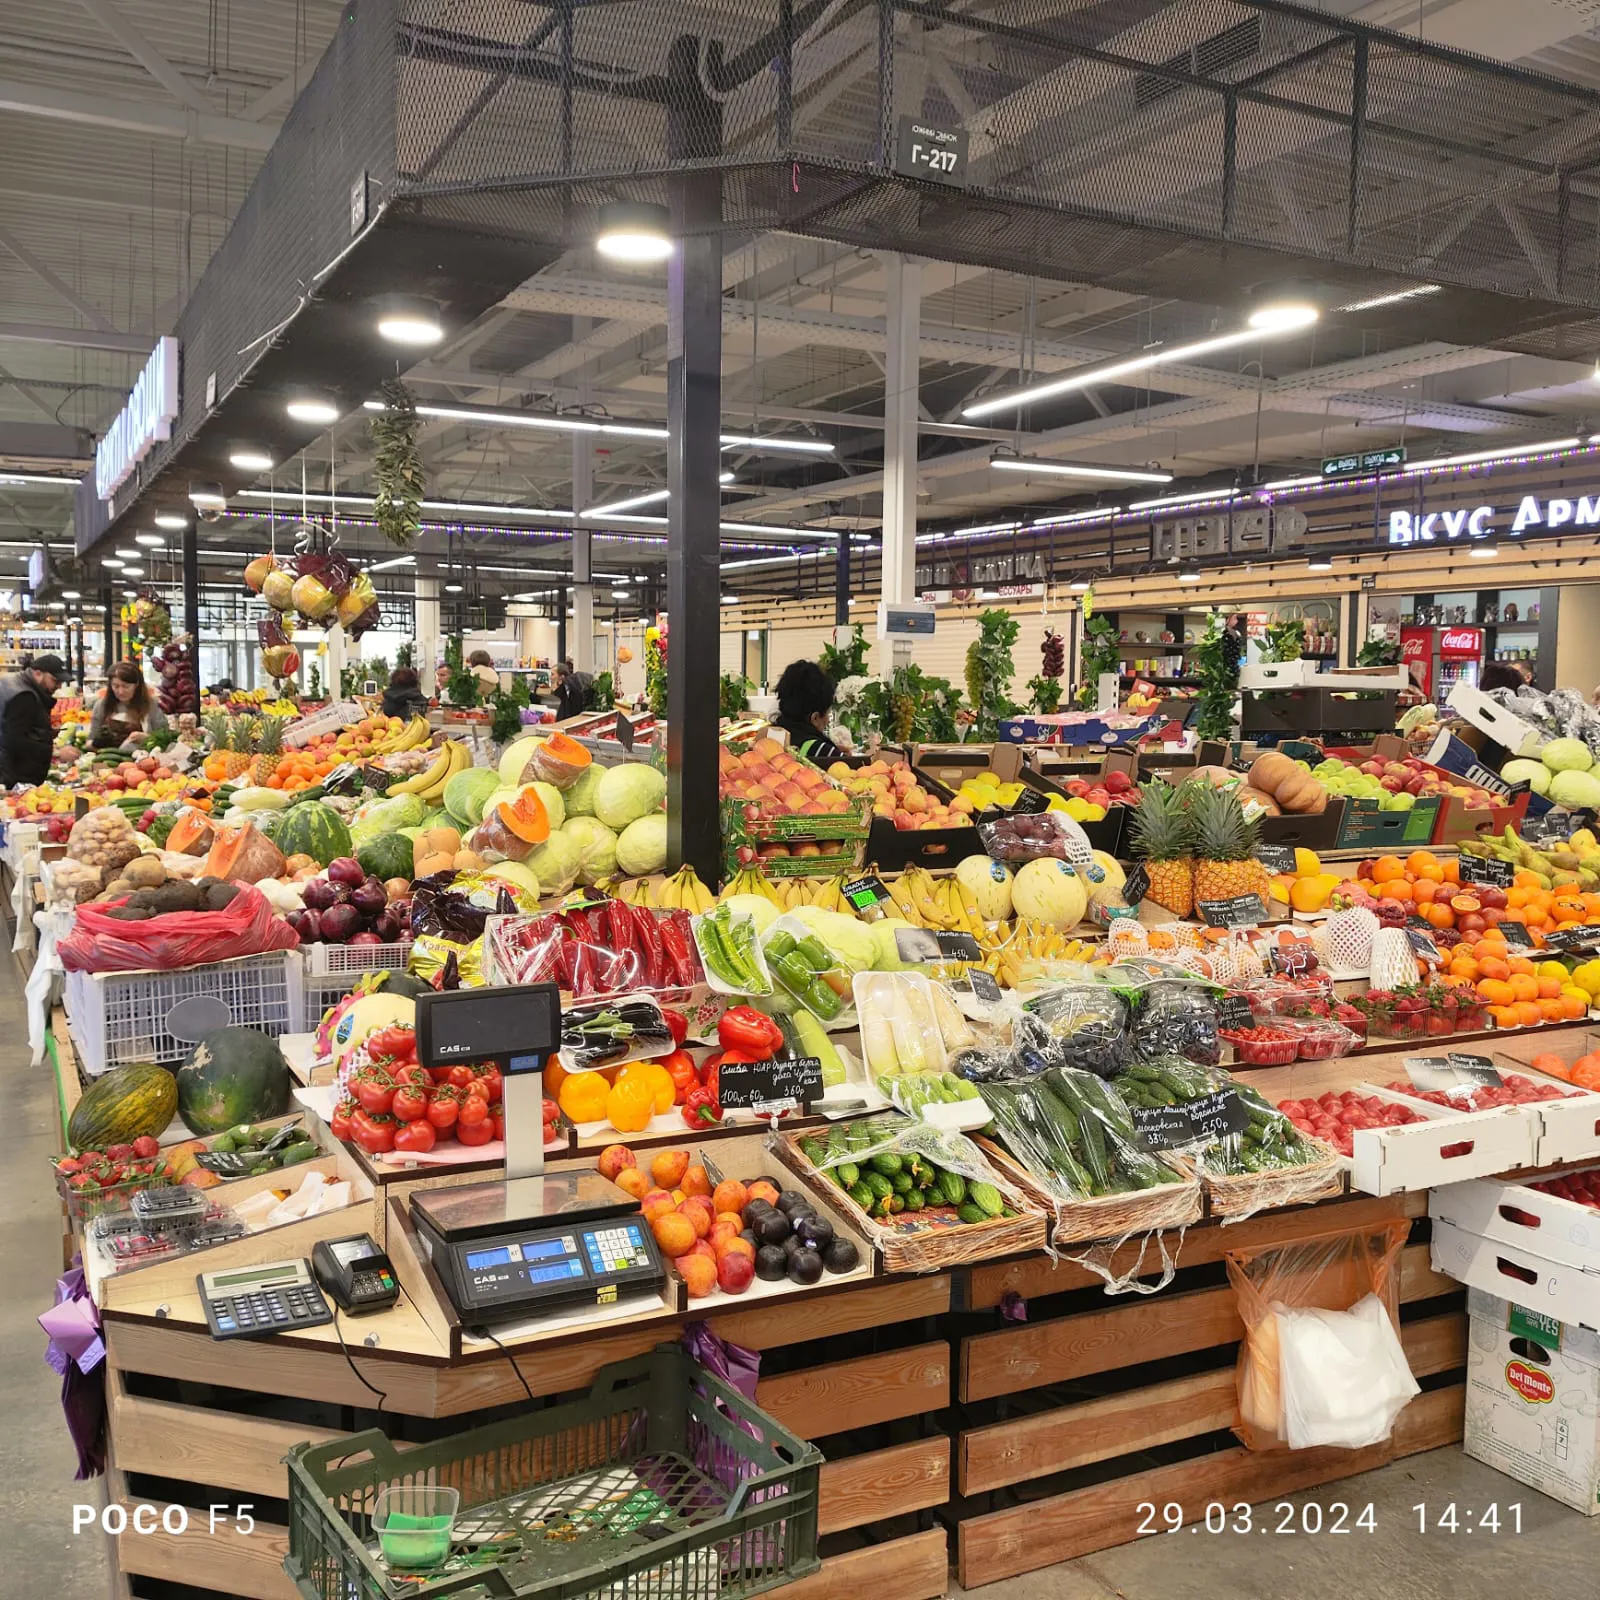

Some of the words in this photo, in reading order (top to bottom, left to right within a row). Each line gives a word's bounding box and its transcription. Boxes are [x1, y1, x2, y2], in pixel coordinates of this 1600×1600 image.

[911, 144, 958, 172] Г-217
[440, 1045, 460, 1054] CAS
[474, 1275, 497, 1284] CAS
[1538, 1312, 1560, 1337] YES
[1508, 1368, 1523, 1383] Del
[1523, 1374, 1552, 1396] Monte
